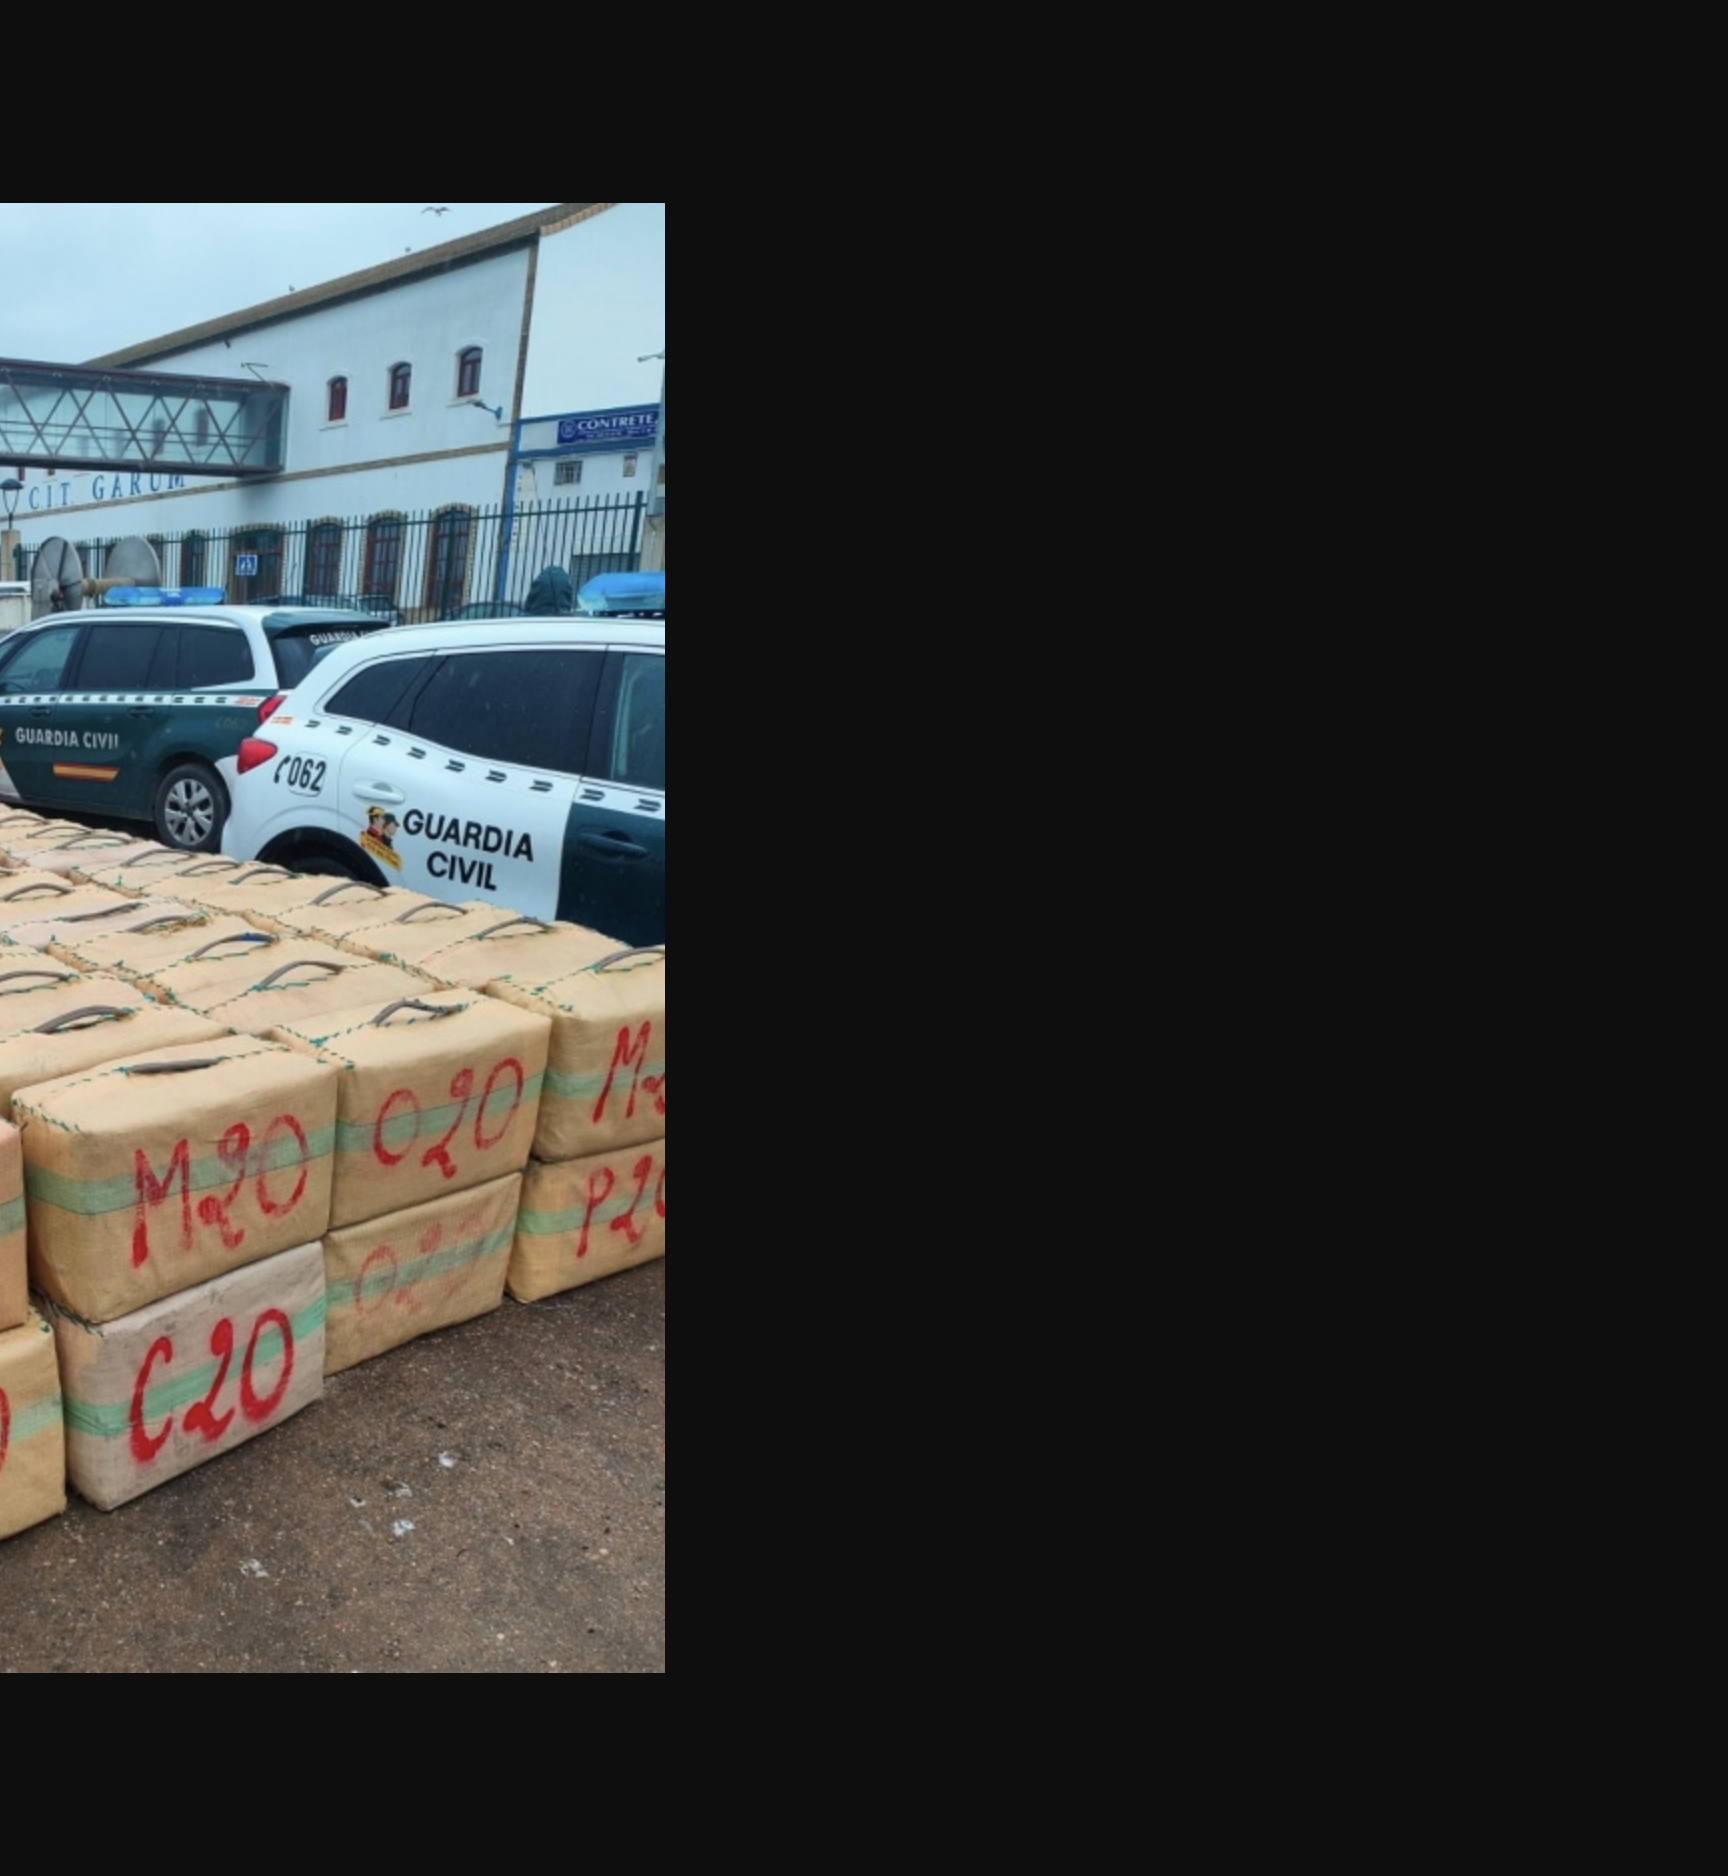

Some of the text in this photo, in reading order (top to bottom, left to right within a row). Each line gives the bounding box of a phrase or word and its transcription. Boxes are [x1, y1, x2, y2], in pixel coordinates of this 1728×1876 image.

[578, 413, 658, 430] CONTRETE
[92, 471, 186, 500] GARUM
[15, 727, 80, 749] GUARDIA
[287, 756, 327, 792] 062
[403, 808, 534, 862] GUARDIA
[426, 851, 497, 891] CIVIL
[132, 1113, 309, 1270] M20
[575, 1154, 665, 1259] P2
[129, 1308, 295, 1464] C20
